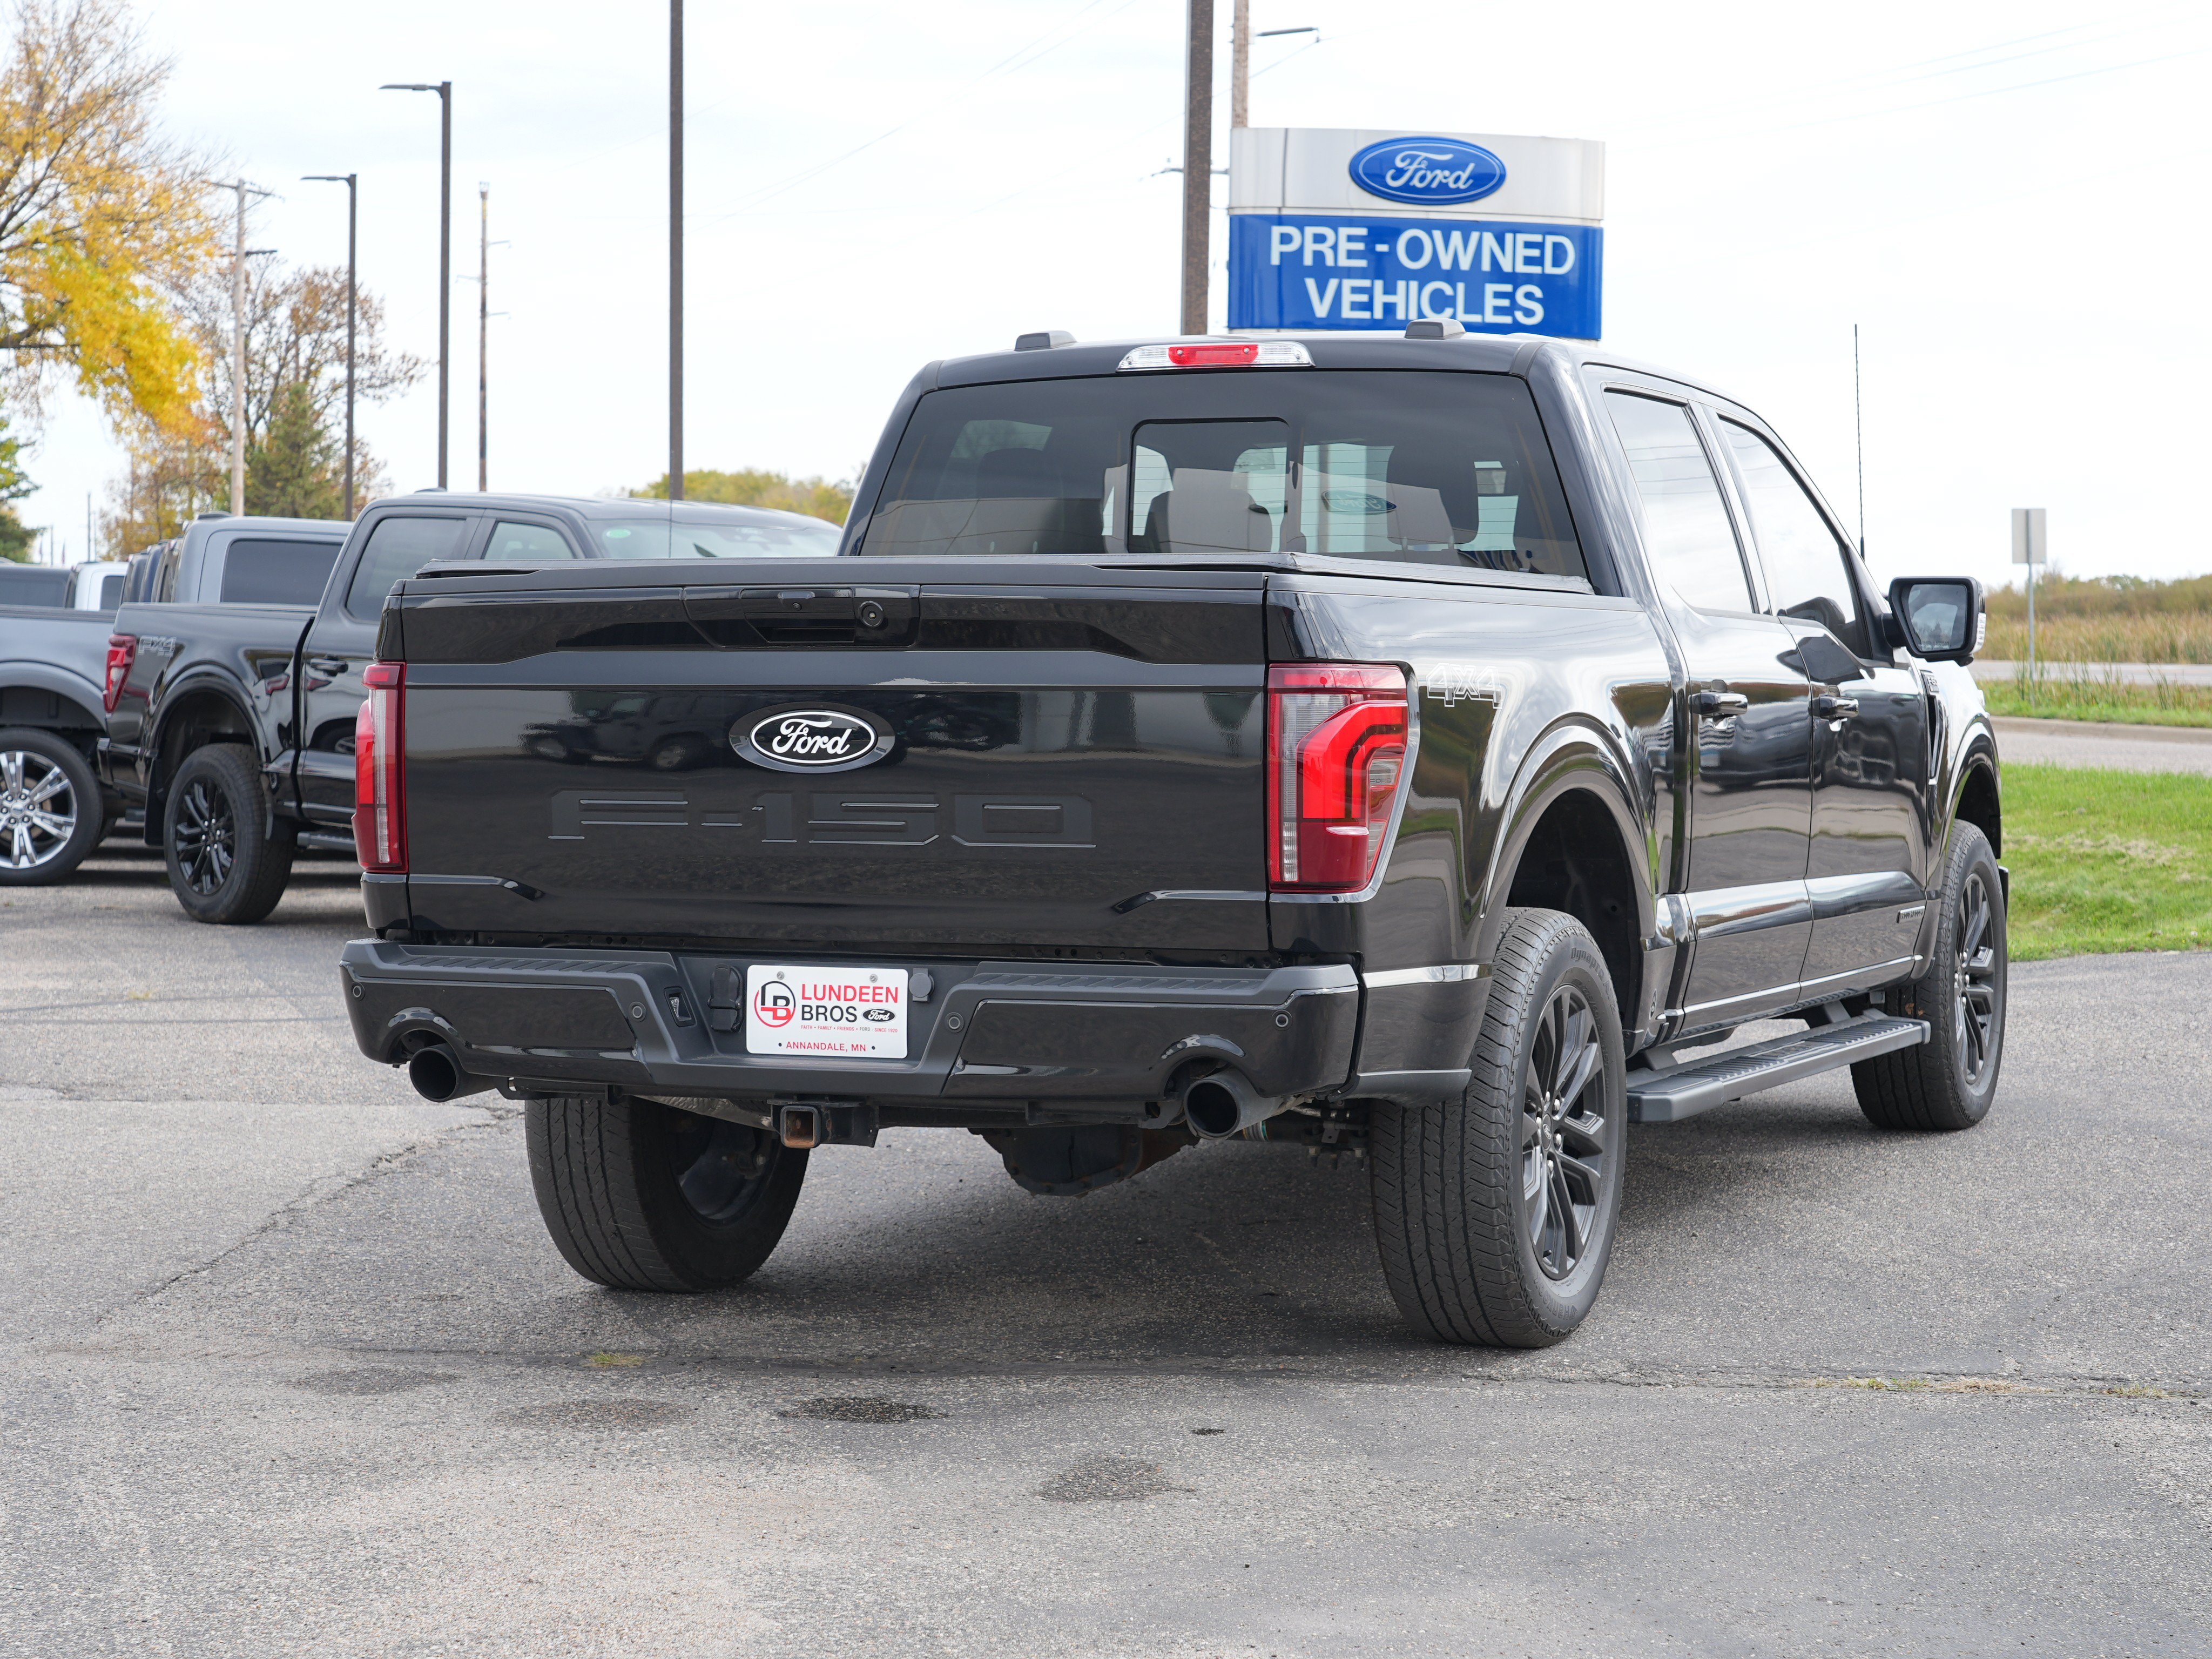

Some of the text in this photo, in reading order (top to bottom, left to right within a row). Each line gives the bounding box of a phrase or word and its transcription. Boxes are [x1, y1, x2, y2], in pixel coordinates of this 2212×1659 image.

[1385, 150, 1476, 190] Ford
[1305, 277, 1545, 326] VEHICLES
[138, 635, 177, 656] FX4
[771, 717, 852, 756] Ford
[548, 790, 1096, 848] F-150
[1570, 947, 1604, 981] Dynapro
[801, 983, 898, 1003] LUNDEEN
[801, 1004, 858, 1023] BROS
[868, 1009, 890, 1022] Ford
[786, 1041, 866, 1053] ANNANDALE, MN
